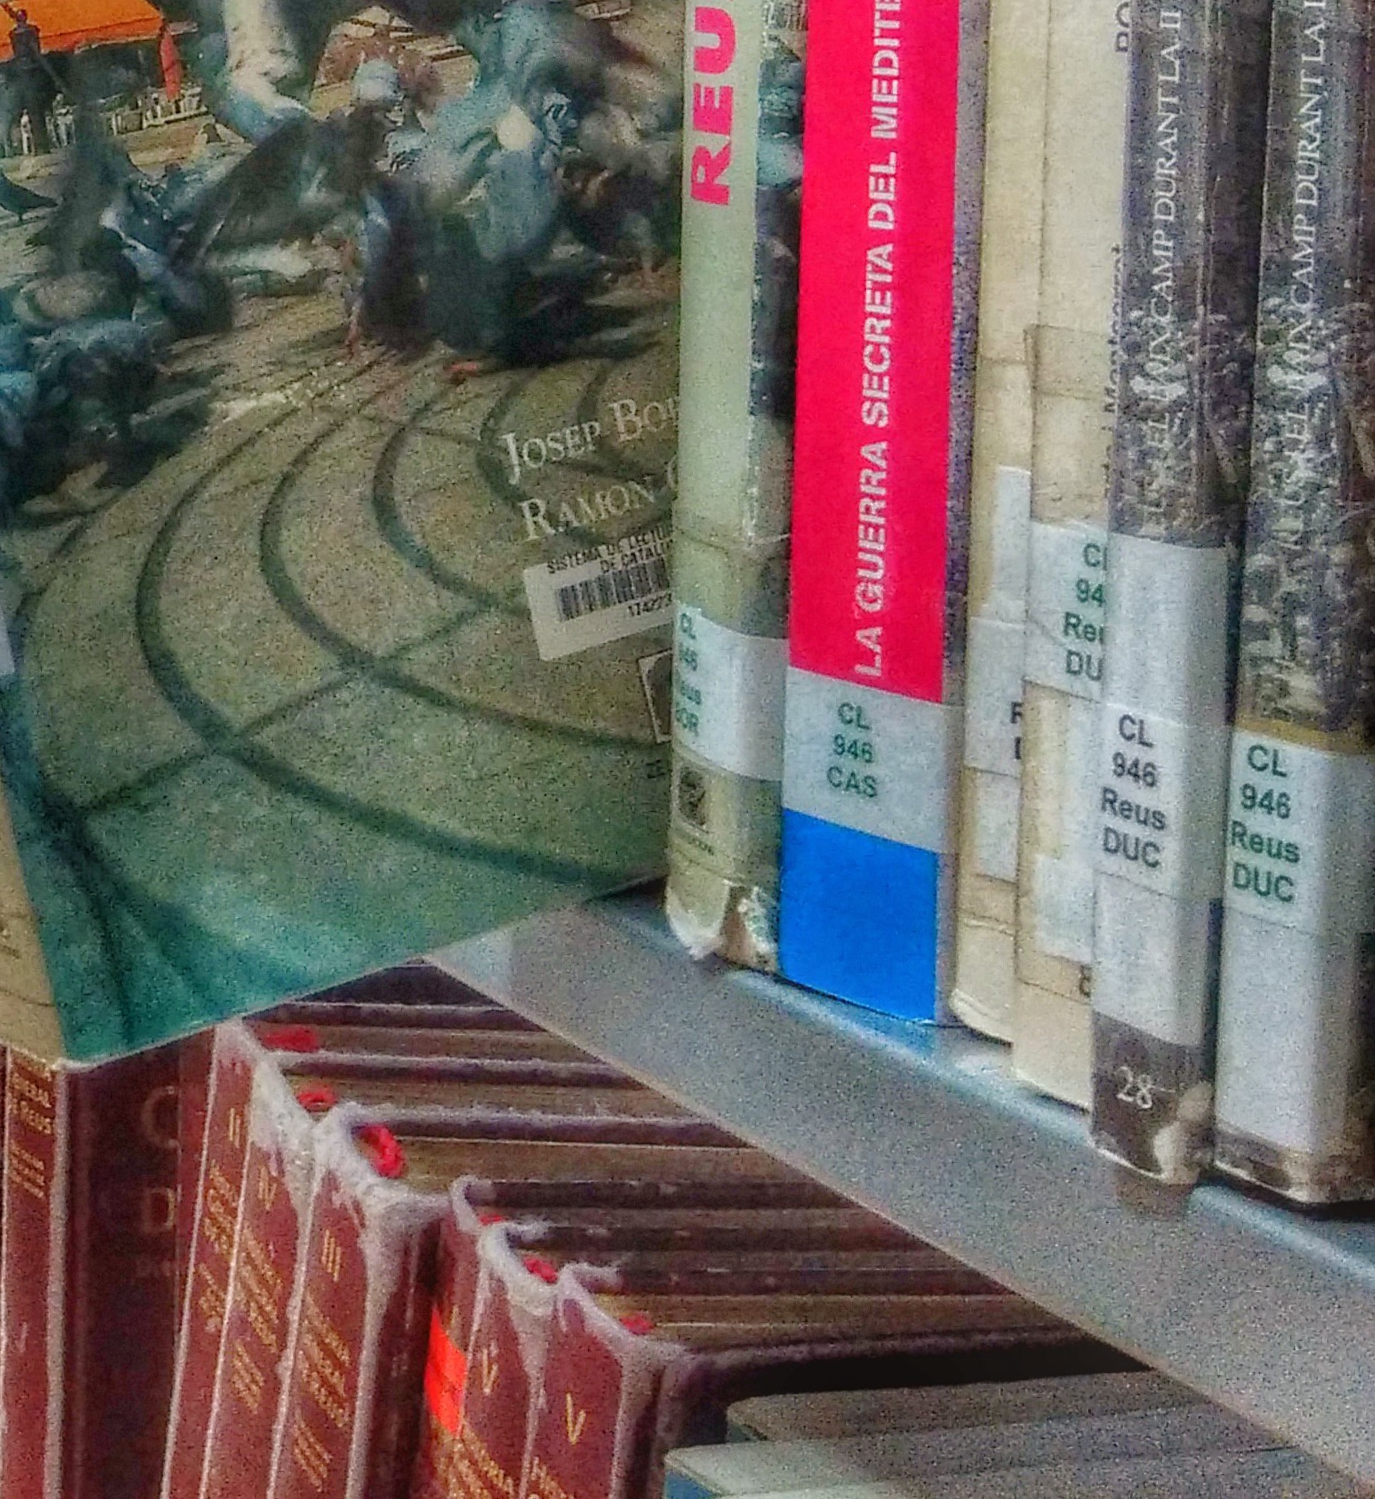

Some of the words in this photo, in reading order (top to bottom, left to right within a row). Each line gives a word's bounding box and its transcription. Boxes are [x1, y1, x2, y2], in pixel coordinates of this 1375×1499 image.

[1159, 8, 1182, 30] II
[1157, 43, 1181, 83] LA
[1300, 24, 1327, 65] LA
[1152, 90, 1181, 223] DURANT
[1292, 68, 1324, 208] DURANT
[867, 149, 899, 231] DEL
[1150, 228, 1175, 319] CAMP
[1289, 214, 1317, 306] CAMP
[861, 241, 898, 428] SECRETA
[855, 440, 889, 614] GUERRA
[1075, 577, 1105, 603] 94
[853, 623, 884, 679] LA
[1066, 650, 1103, 681] DU
[837, 701, 871, 731] CL
[1118, 714, 1154, 748] CL
[832, 734, 874, 764] 946
[1112, 751, 1159, 788] 946
[1247, 744, 1288, 779] CL
[826, 765, 878, 799] CAS
[1241, 782, 1292, 820] 946
[1100, 786, 1166, 832] Reus
[1102, 826, 1161, 870] DUC
[1230, 819, 1301, 865] Reus
[1232, 862, 1295, 904] DUC
[1114, 1065, 1154, 1109] 28
[322, 1228, 342, 1283] III
[564, 1391, 587, 1446] V
